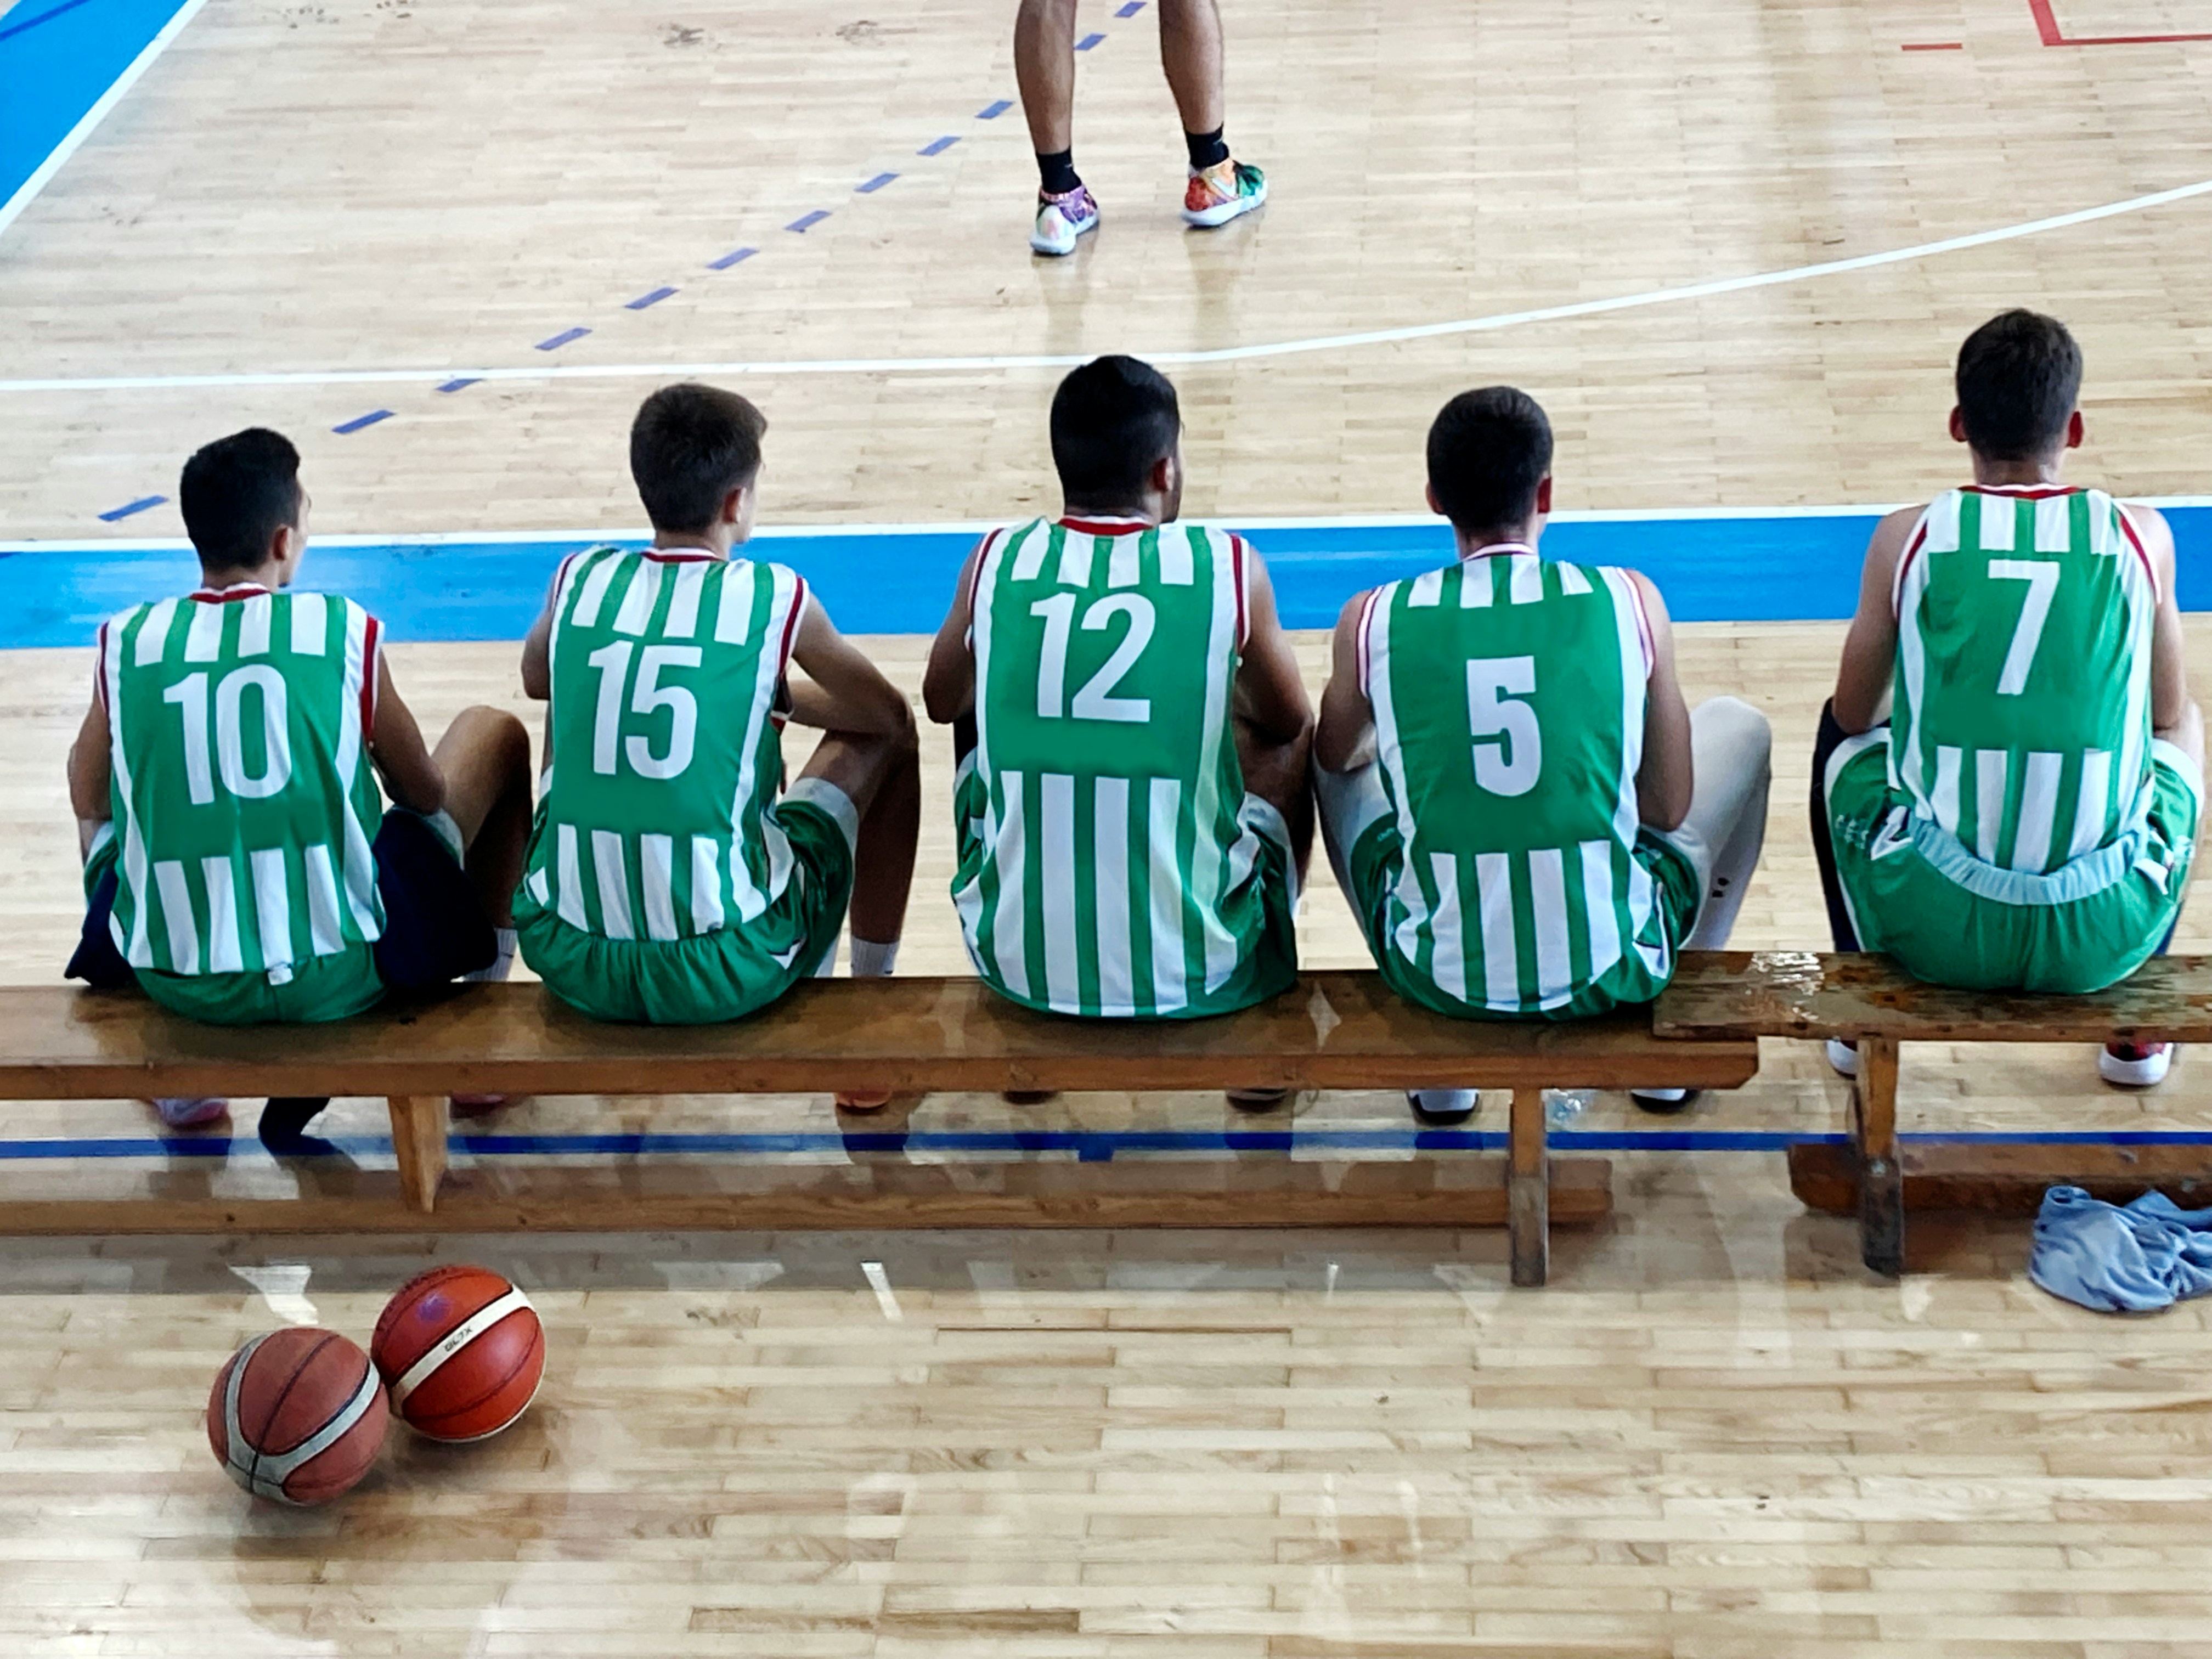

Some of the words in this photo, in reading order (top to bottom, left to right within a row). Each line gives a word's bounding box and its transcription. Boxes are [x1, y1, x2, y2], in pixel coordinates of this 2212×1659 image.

[1030, 592, 1155, 722] 12
[1988, 560, 2060, 695] 7
[164, 664, 292, 804] 10
[588, 640, 702, 780] 15
[1466, 656, 1542, 797] 5
